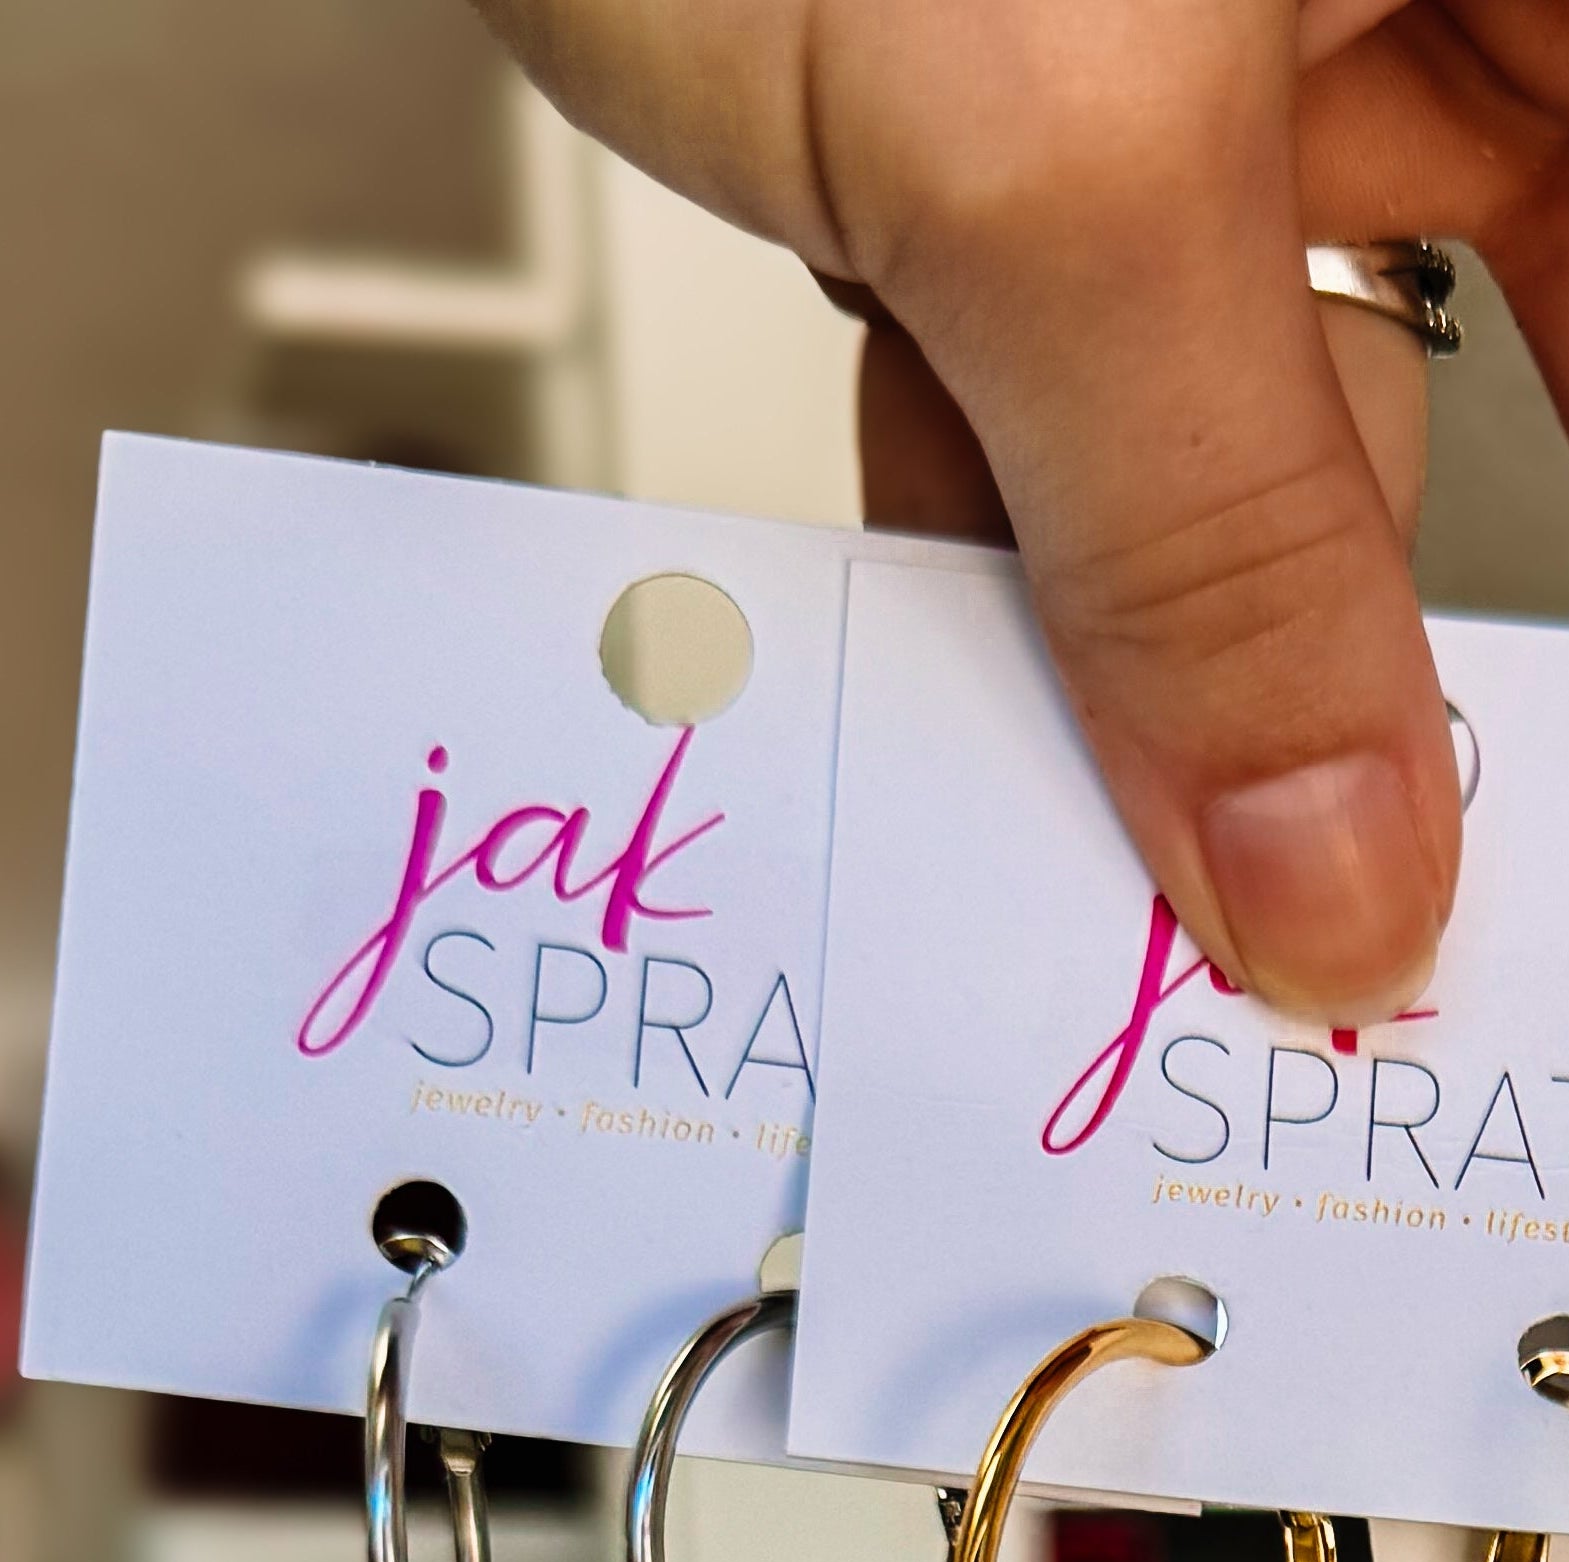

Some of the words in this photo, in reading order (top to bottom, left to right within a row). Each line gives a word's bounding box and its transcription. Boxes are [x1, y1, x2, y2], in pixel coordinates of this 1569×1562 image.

[297, 722, 727, 1057] jak
[409, 930, 817, 1104] SPRA
[410, 1080, 544, 1123] jewelry
[579, 1101, 716, 1144] fashion
[1151, 1173, 1281, 1217] jewelry
[1315, 1191, 1447, 1231] fashion
